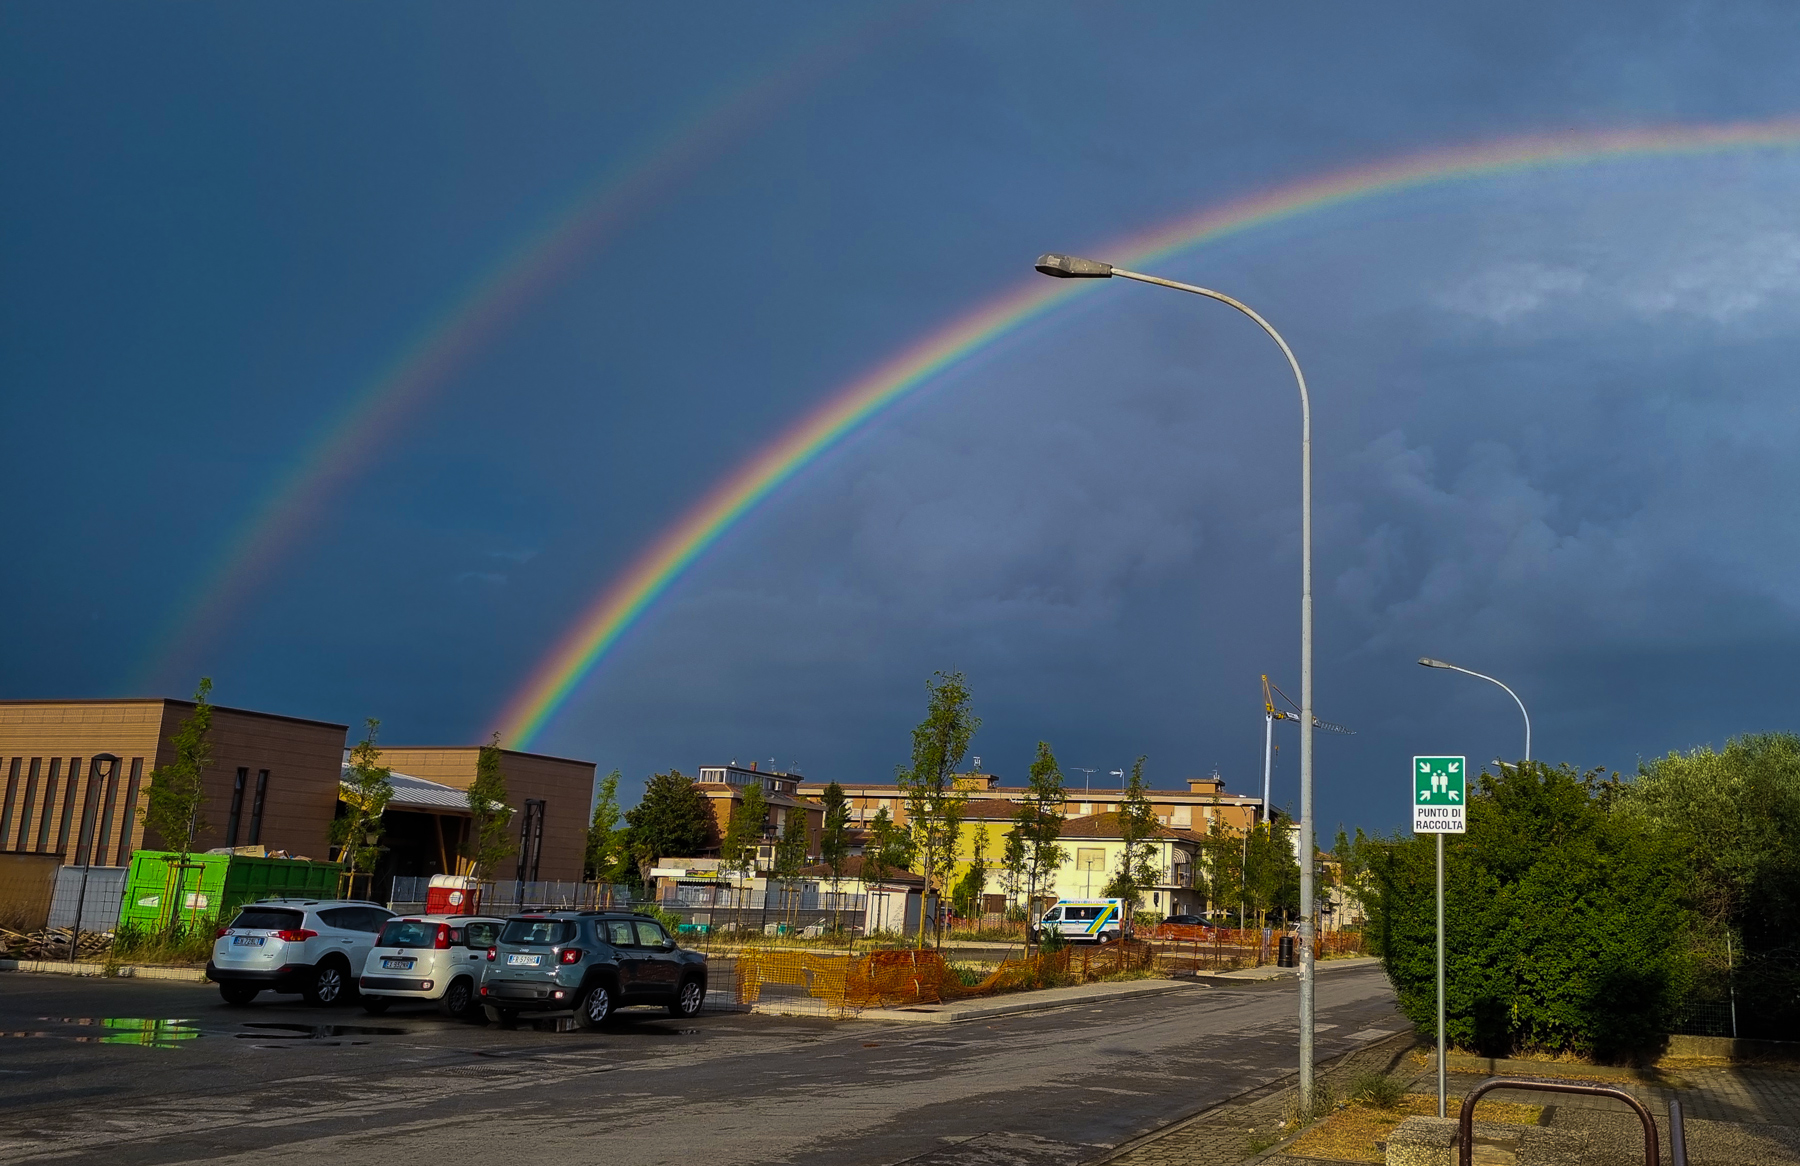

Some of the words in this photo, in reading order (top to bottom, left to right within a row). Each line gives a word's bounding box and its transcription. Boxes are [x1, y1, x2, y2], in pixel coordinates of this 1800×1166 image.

[1418, 808, 1448, 817] PUNTO
[1451, 808, 1461, 817] DI
[1416, 821, 1463, 830] RACCOLTA
